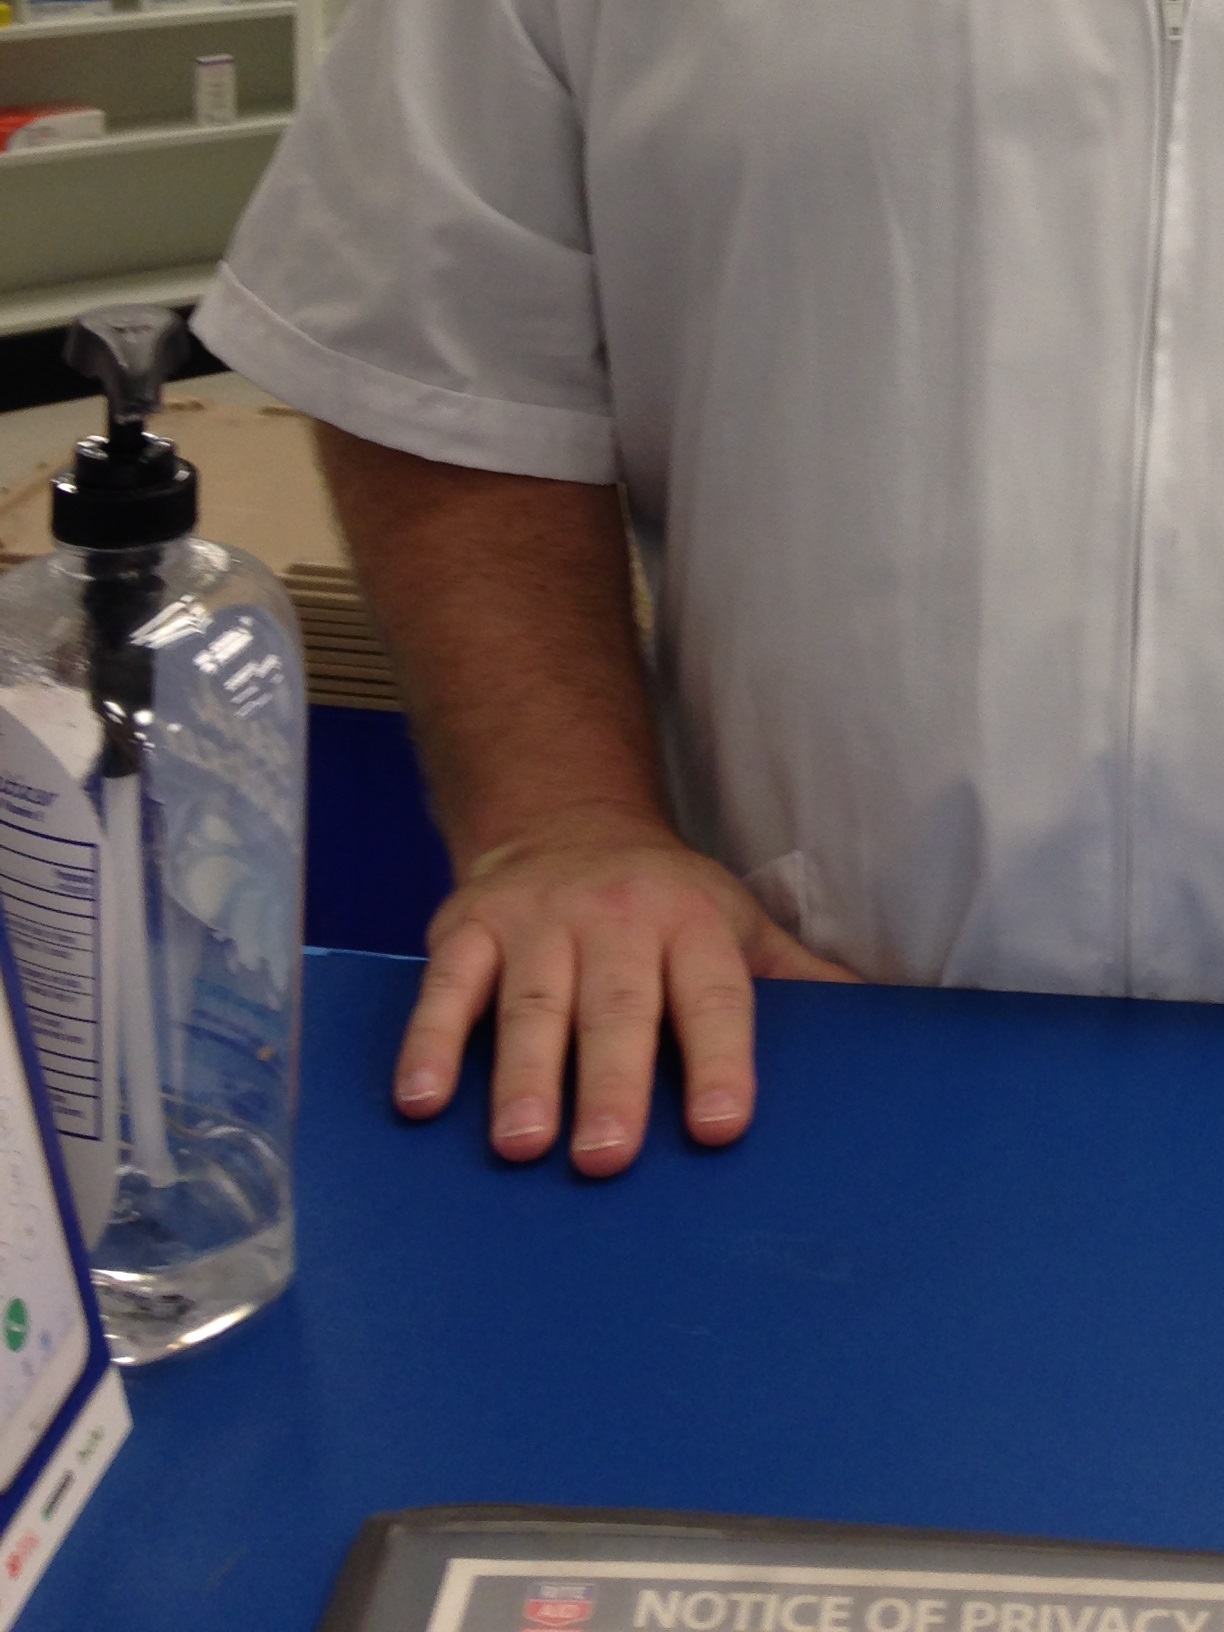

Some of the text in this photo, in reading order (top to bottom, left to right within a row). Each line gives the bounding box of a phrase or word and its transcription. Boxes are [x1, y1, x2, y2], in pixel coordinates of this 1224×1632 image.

[633, 1589, 855, 1632] NOTICE
[864, 1597, 947, 1632] OF
[960, 1601, 1210, 1632] PRIVACY
